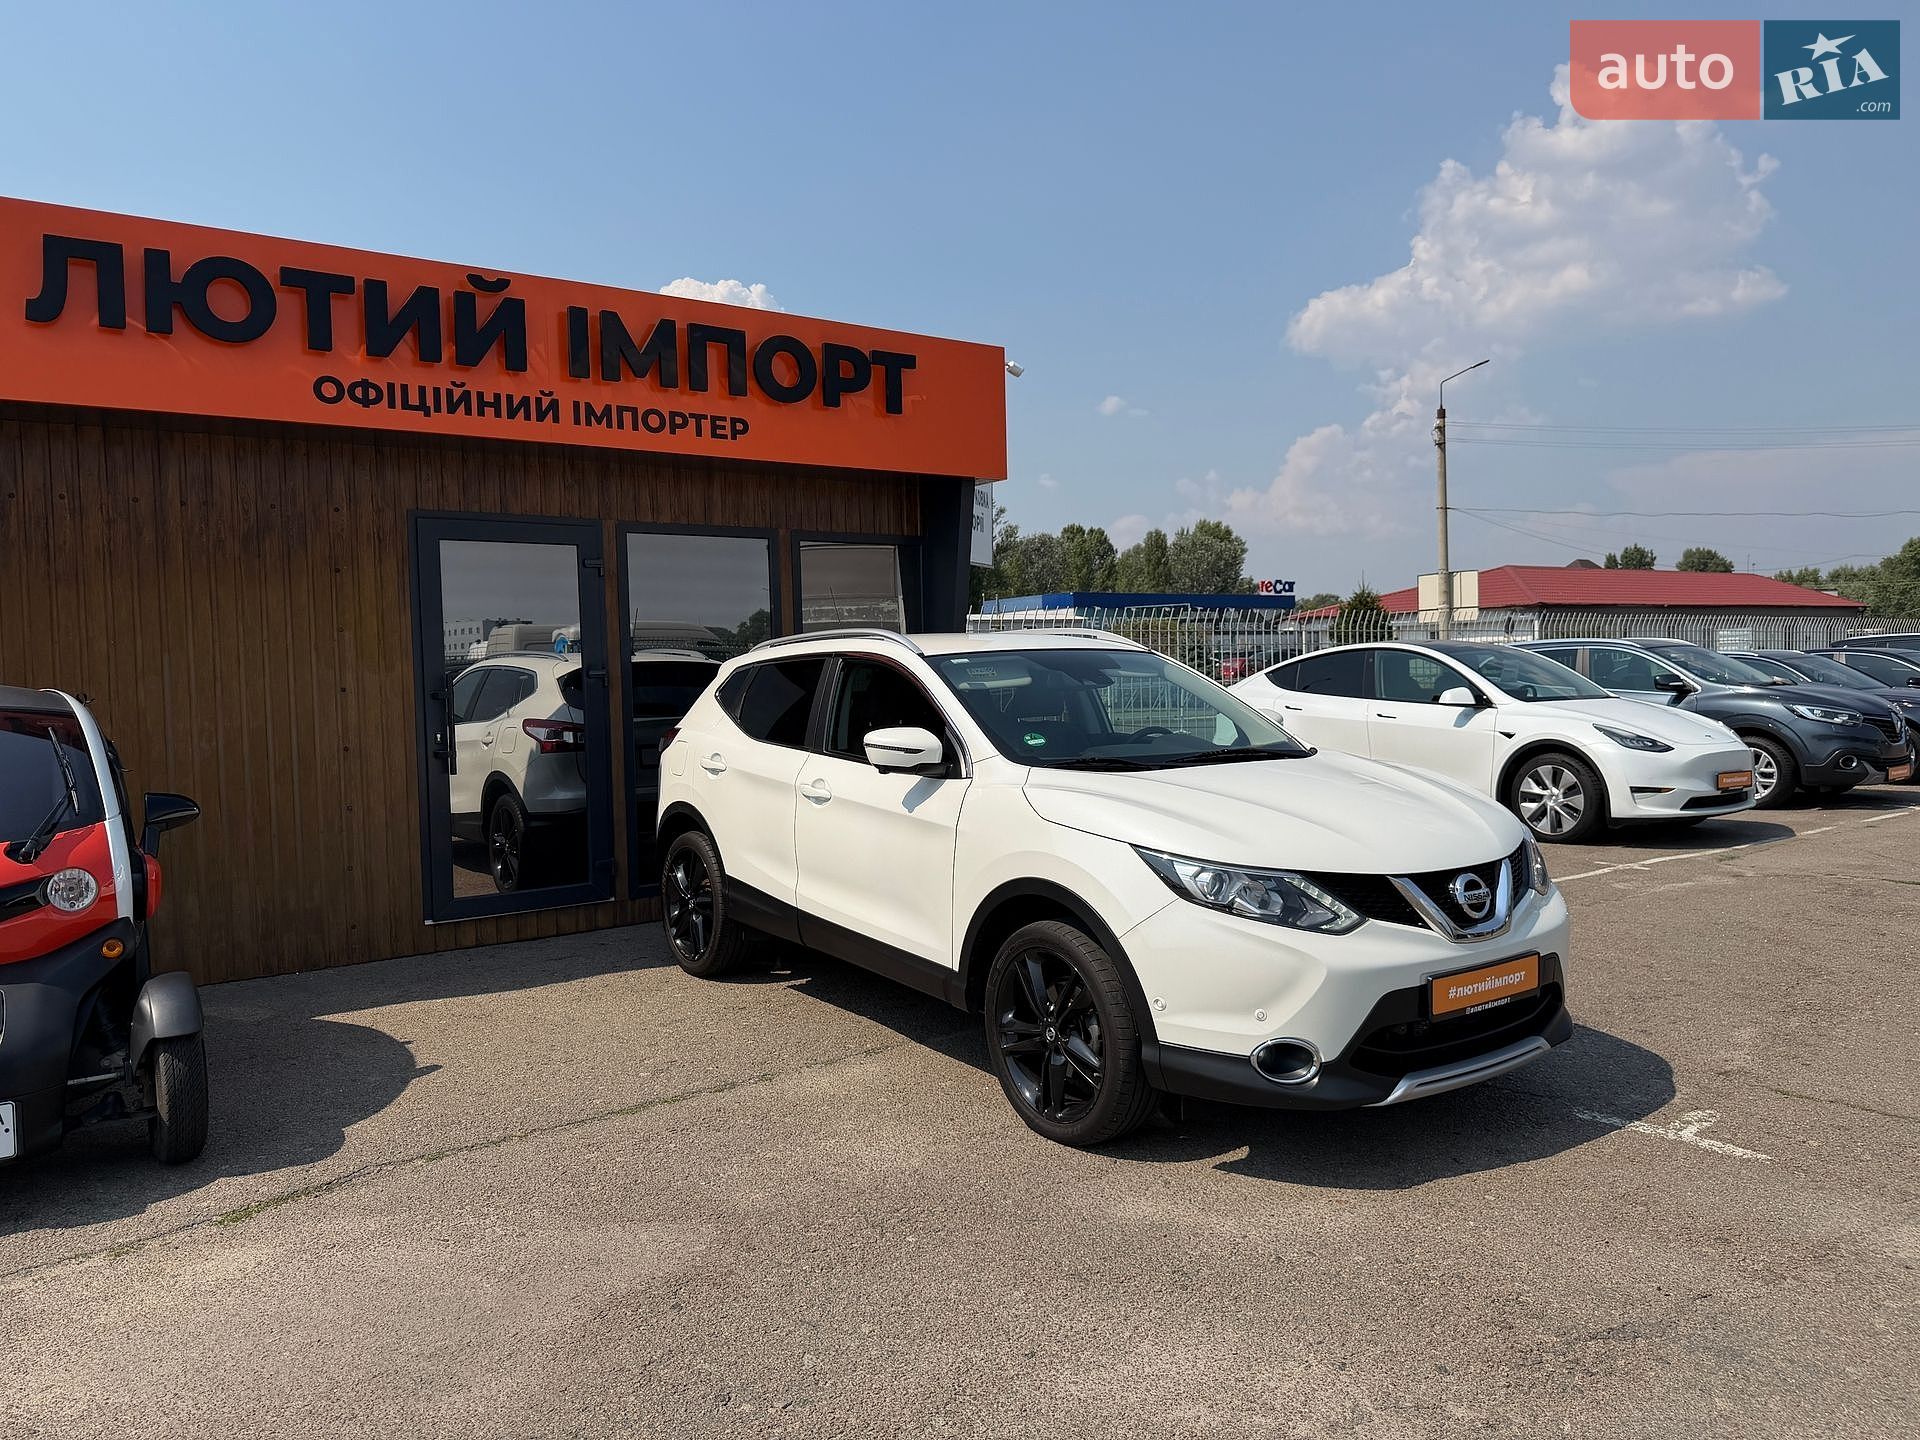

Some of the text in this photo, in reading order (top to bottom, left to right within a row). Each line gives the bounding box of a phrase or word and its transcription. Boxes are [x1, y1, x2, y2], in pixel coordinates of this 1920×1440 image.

[25, 233, 917, 415] ЛЮТИЙ ІМПОРТ
[313, 375, 750, 441] ОФІЦІЙНИЙ ІМПОРТЕР
[1448, 970, 1526, 1000] #лютийімпорт
